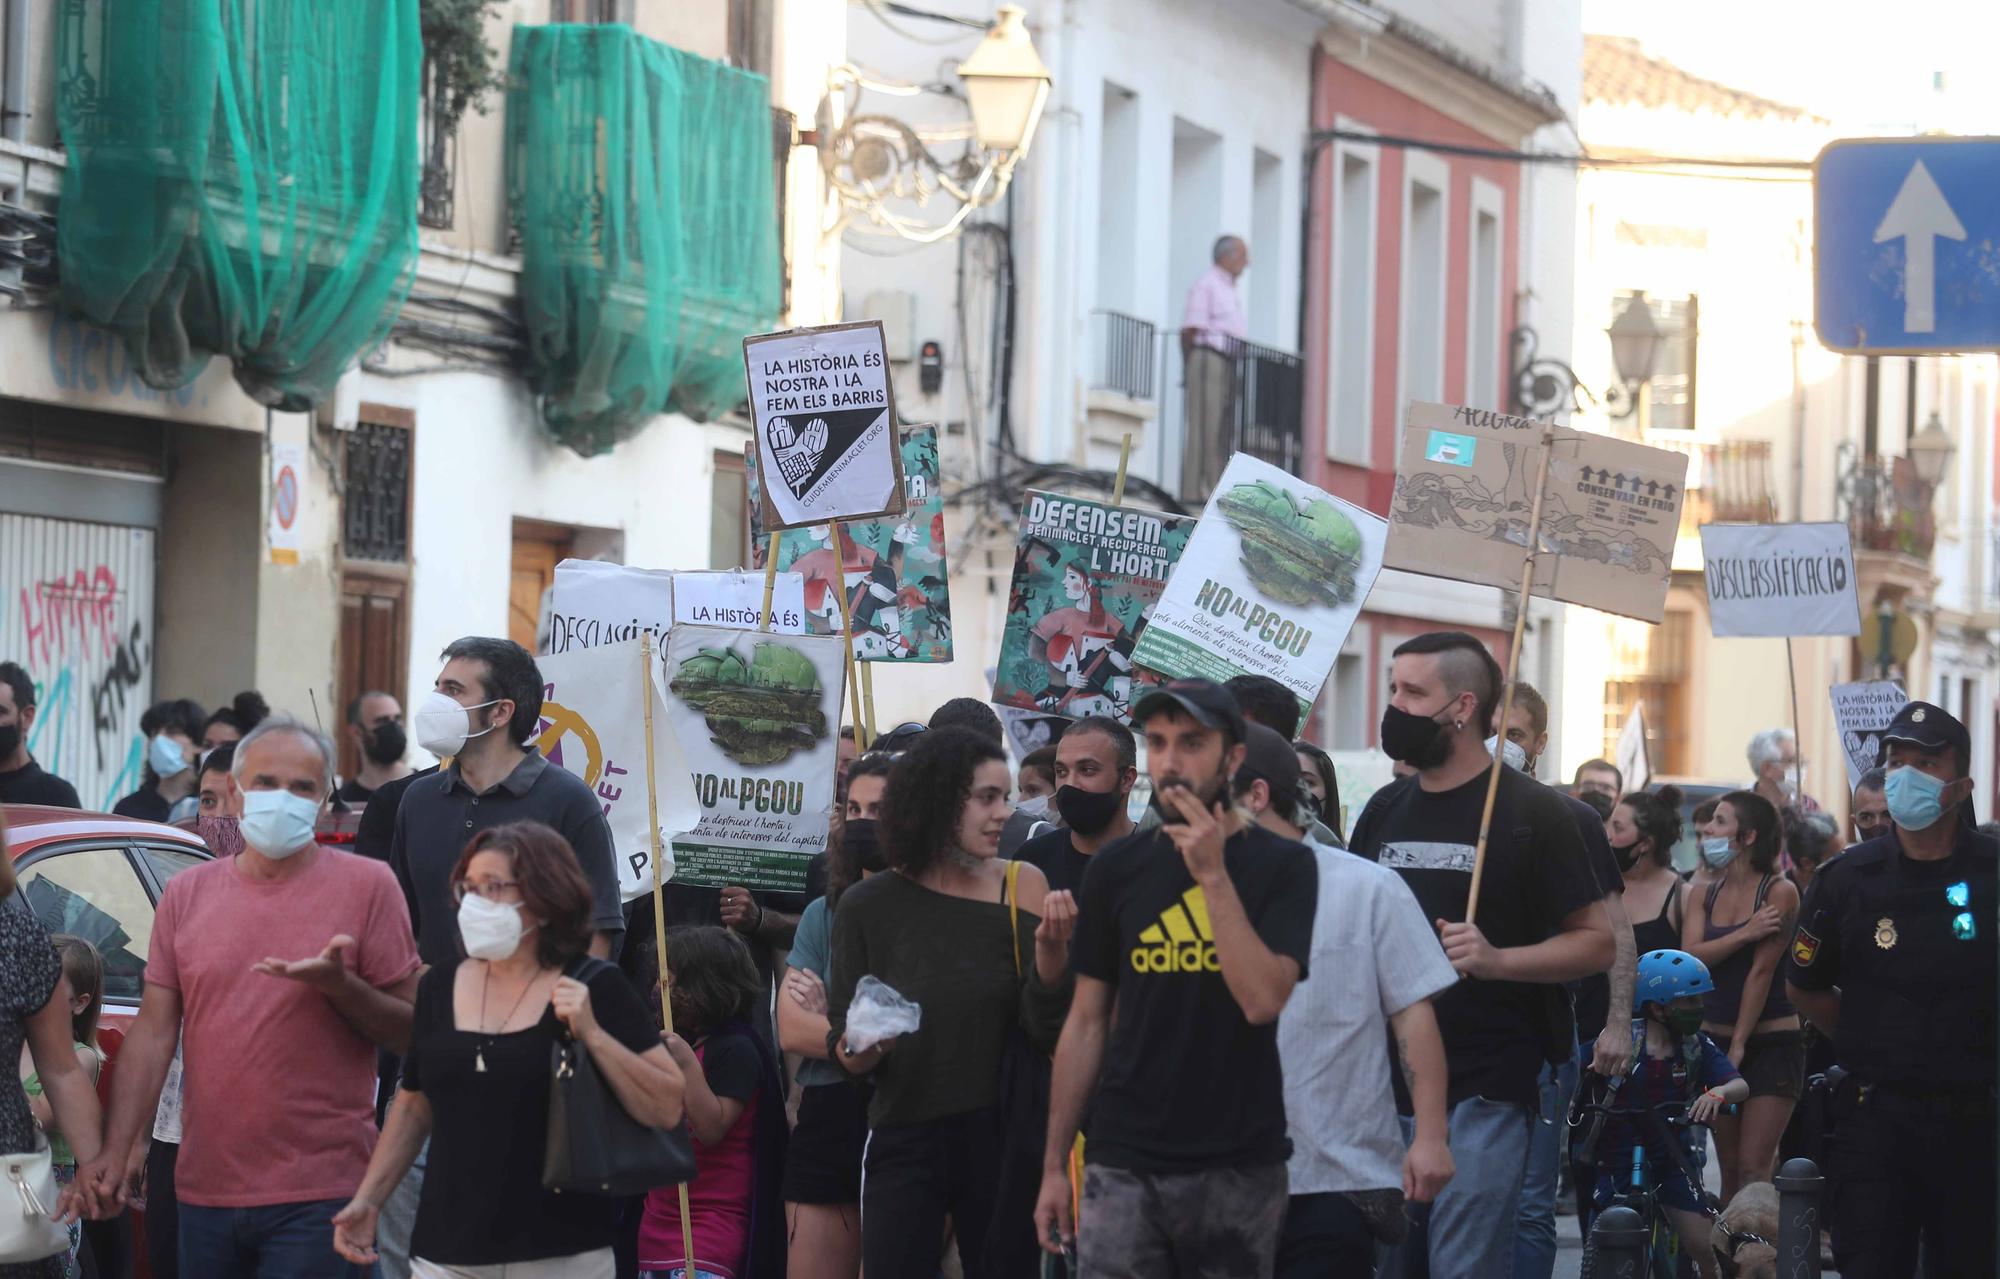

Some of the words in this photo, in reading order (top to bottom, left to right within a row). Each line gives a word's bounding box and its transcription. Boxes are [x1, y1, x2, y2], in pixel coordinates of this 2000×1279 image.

[764, 360, 784, 376] LA
[788, 353, 859, 374] HISTÒRIA
[864, 350, 881, 368] ÉS
[766, 376, 829, 394] NOSTRA
[834, 374, 840, 388] I
[844, 373, 863, 388] LA
[767, 397, 799, 412] FEM
[804, 394, 827, 409] ELS
[832, 389, 885, 407] BARRIS
[803, 424, 883, 508] CUIDEMBENIMACLET.ORG
[1577, 482, 1635, 504] CONSERVAR
[1637, 496, 1650, 507] EN
[1029, 496, 1162, 545] DEFENSEM
[1100, 536, 1167, 559] RECUPEREM
[693, 606, 711, 622] LA
[783, 609, 799, 627] ÉS
[1194, 578, 1233, 618] NO
[1228, 596, 1249, 620] AL
[1243, 602, 1312, 658] PGOU
[1192, 612, 1213, 629] Que
[1213, 624, 1252, 648] destrueix
[1172, 619, 1211, 642] alimenta
[1212, 636, 1225, 649] els
[1226, 644, 1267, 670] interessos
[1267, 665, 1281, 679] del
[1837, 695, 1849, 706] LA
[1850, 692, 1892, 705] HISTÒRIA
[1894, 691, 1906, 704] ÉS
[1840, 707, 1876, 717] NOSTRA
[1885, 705, 1897, 715] LA
[1841, 719, 1861, 728] FEM
[1862, 719, 1876, 728] ELS
[719, 777, 738, 799] AL
[738, 777, 804, 816] PGOU
[711, 813, 752, 828] destrueix
[754, 816, 786, 830] l'horta
[788, 821, 793, 831] i
[715, 829, 728, 839] els
[730, 830, 772, 843] interessos
[774, 833, 789, 844] del
[1130, 940, 1222, 973] adida
